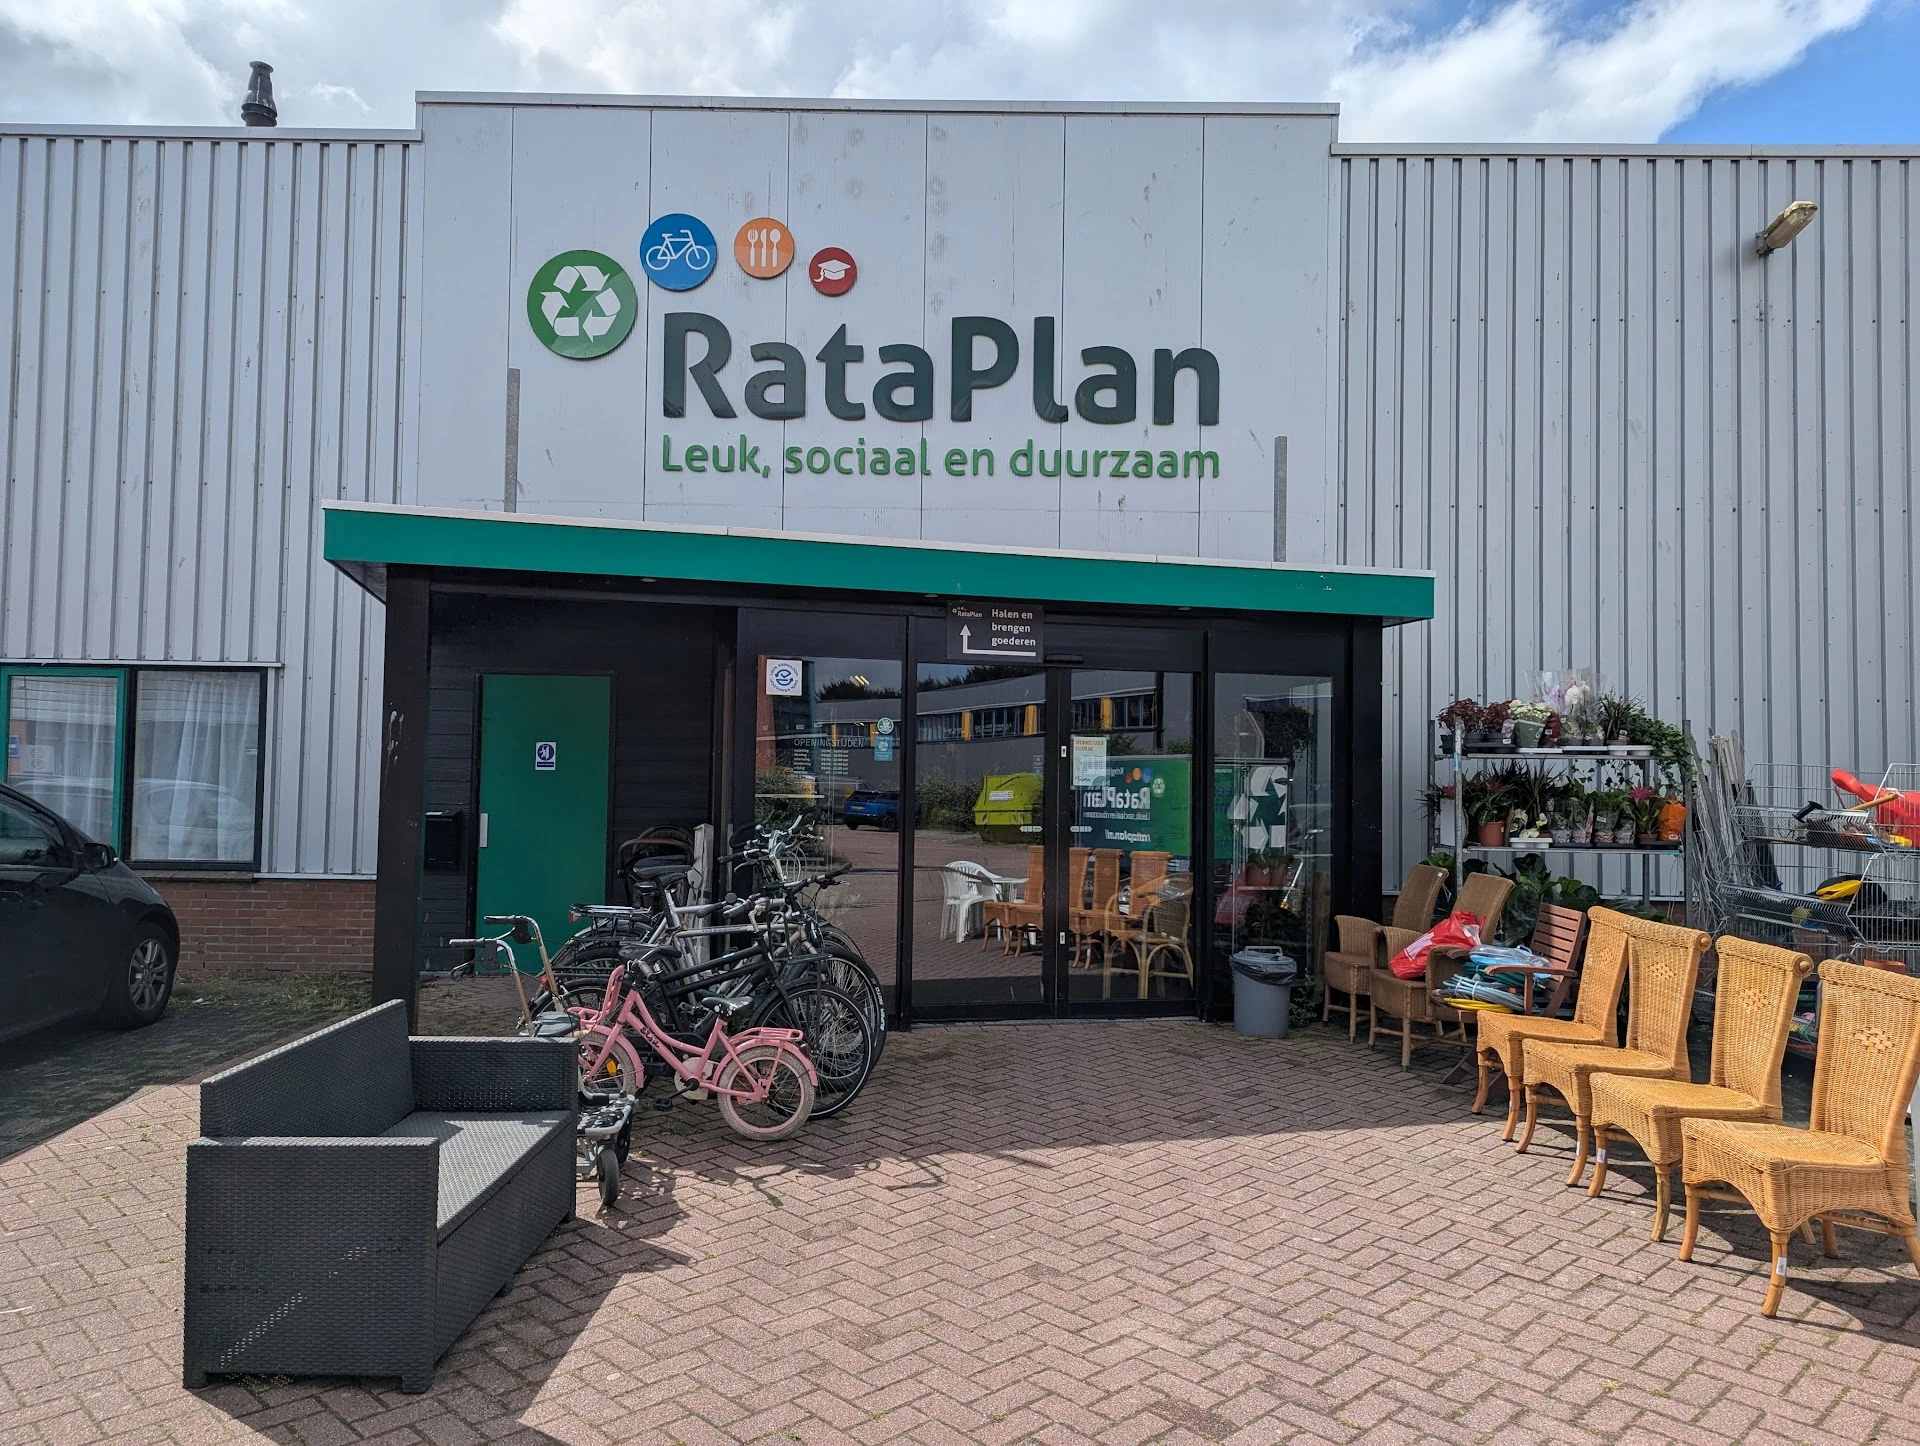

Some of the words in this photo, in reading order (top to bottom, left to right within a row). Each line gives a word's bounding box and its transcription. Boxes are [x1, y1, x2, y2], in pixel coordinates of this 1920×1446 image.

[662, 311, 1221, 426] RataPlan
[662, 434, 770, 478] Leuk,
[784, 437, 931, 476] sociaal
[943, 447, 994, 476] en
[1009, 438, 1221, 478] duurzaam
[991, 609, 1019, 619] Halen
[1021, 612, 1033, 620] en
[991, 622, 1031, 634] brengen
[991, 637, 1036, 646] goederen
[793, 738, 864, 748] OPENINGSTIJDEN
